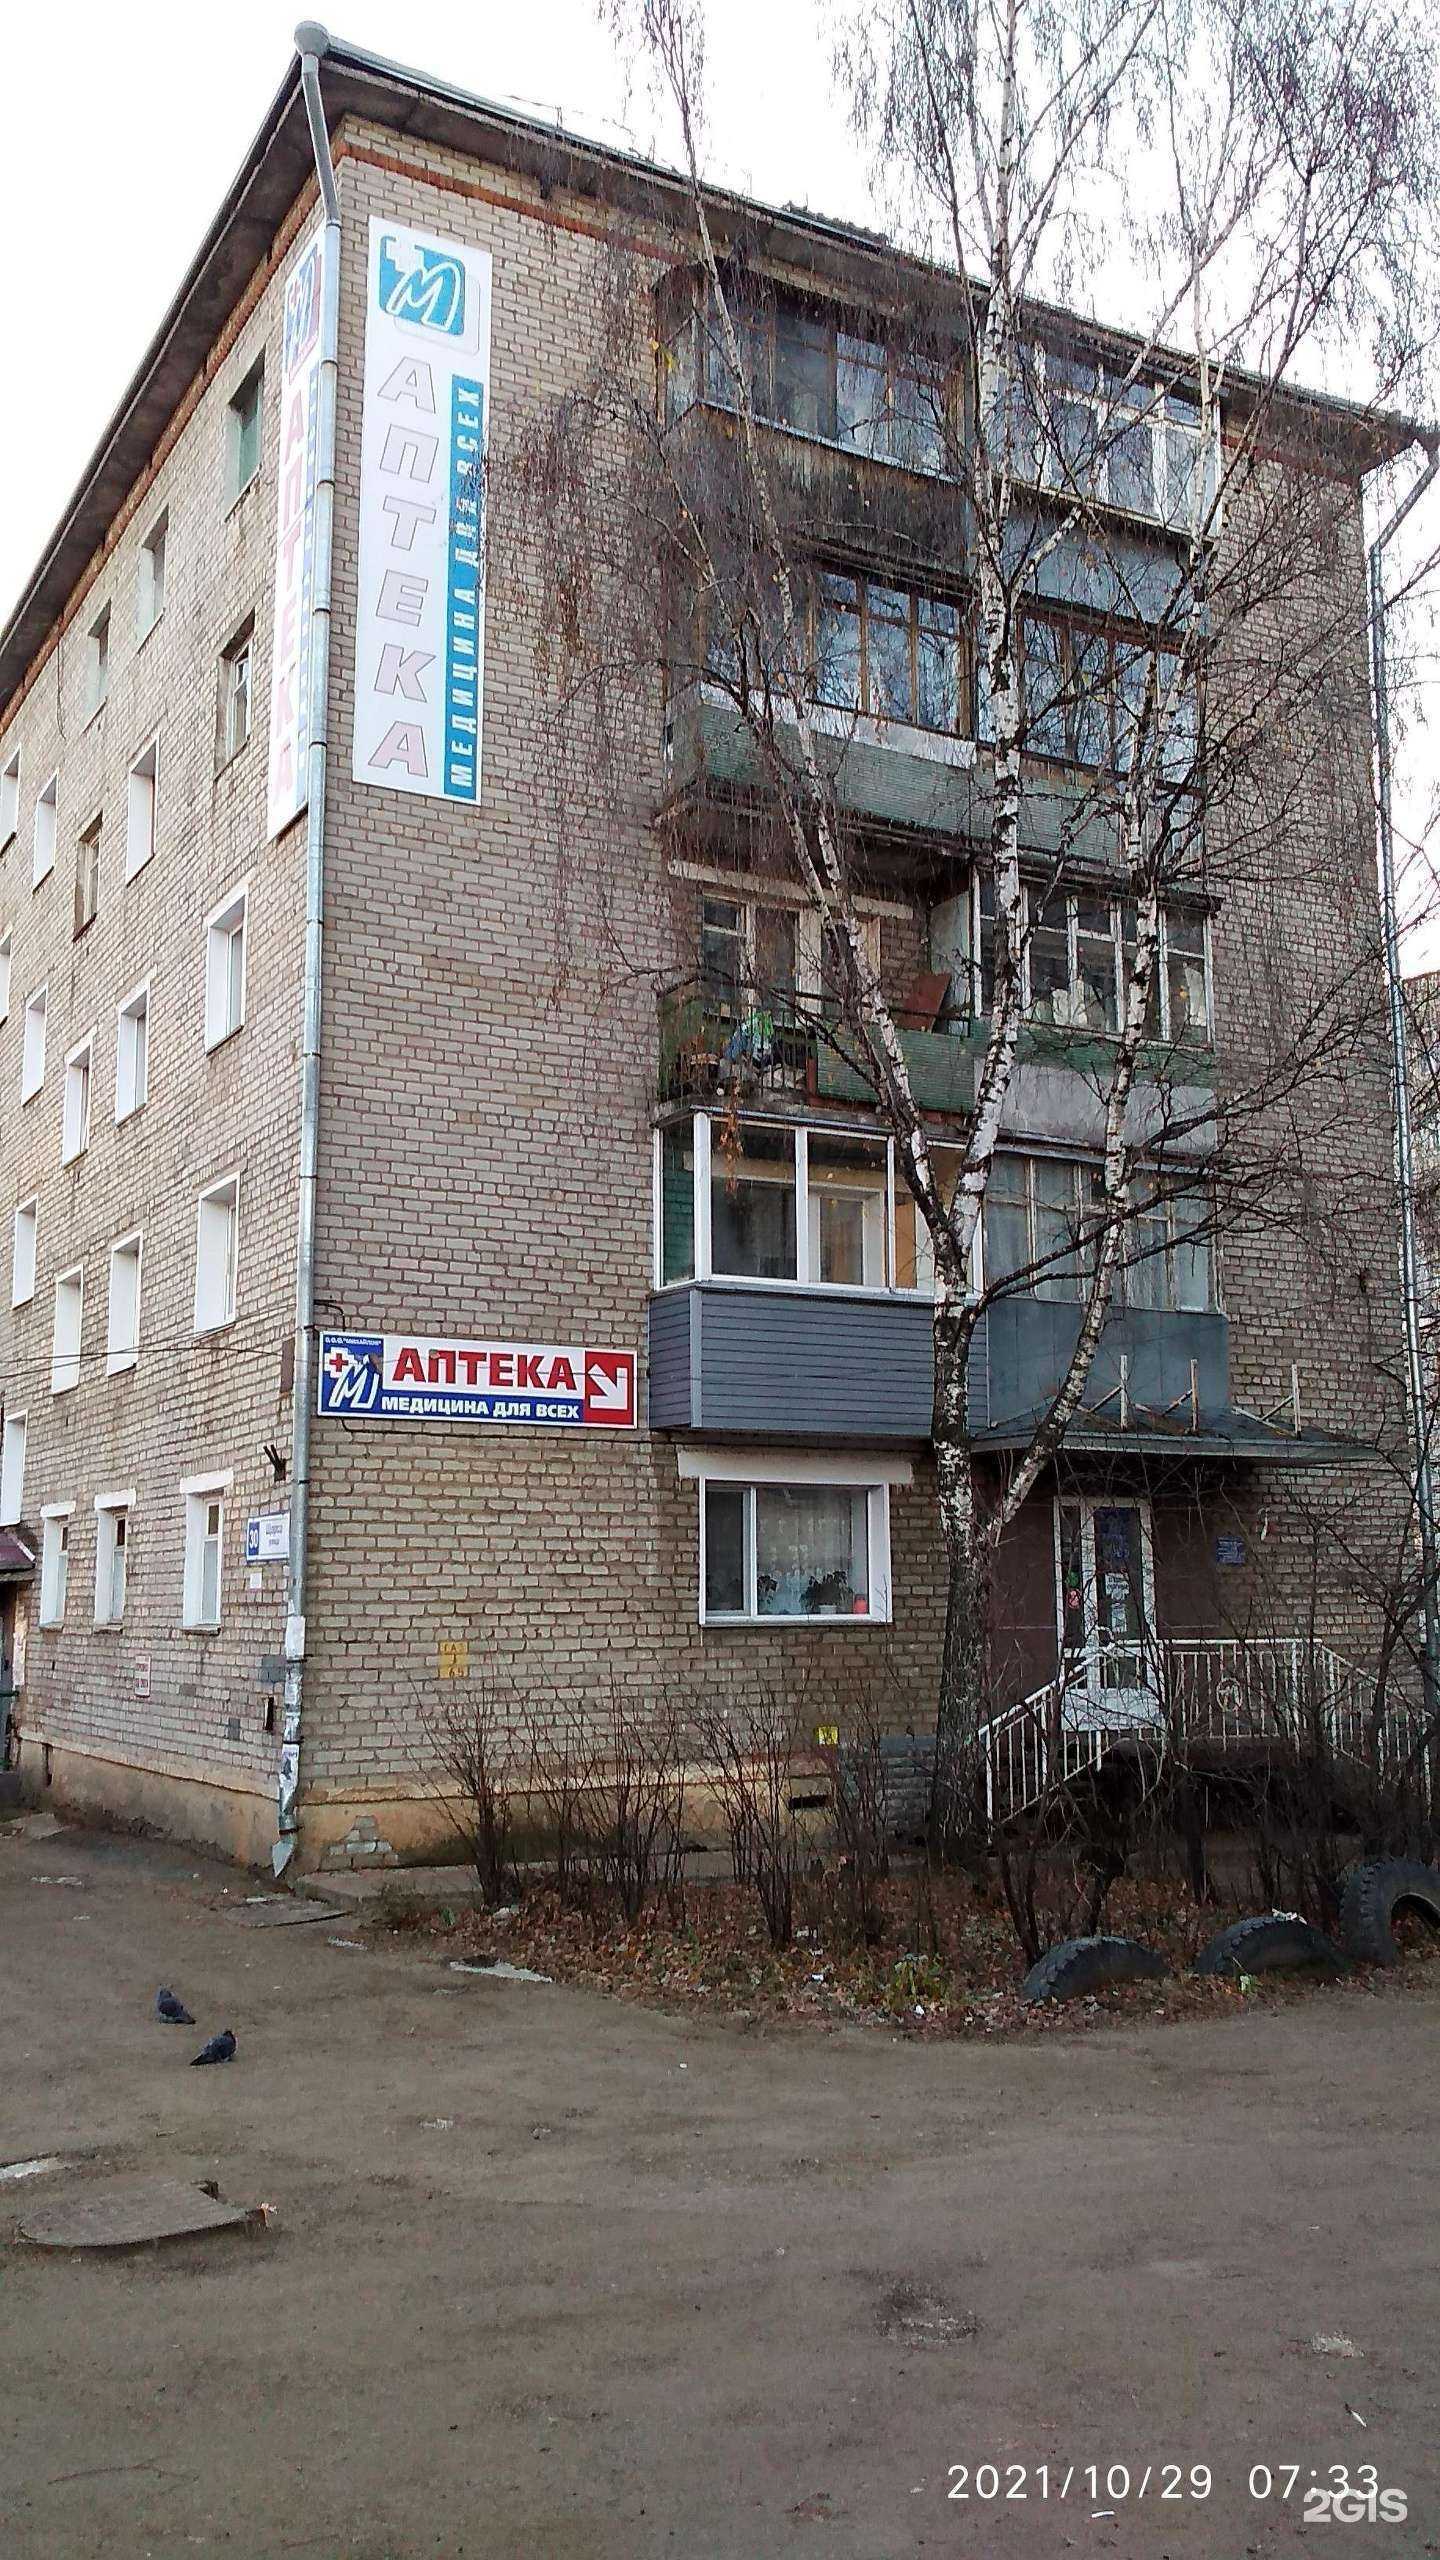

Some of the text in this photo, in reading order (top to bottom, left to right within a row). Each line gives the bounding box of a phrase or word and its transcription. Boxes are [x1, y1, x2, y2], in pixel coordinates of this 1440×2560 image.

[456, 386, 480, 478] ВСЕХ
[368, 356, 439, 778] АПТЕКА
[451, 587, 478, 787] МЕДИЦИНА
[392, 1347, 578, 1391] АПТЕКА
[381, 1396, 579, 1419] МЕДИЦИНА ДЛЯ ВСЕХ
[249, 1529, 259, 1549] 30
